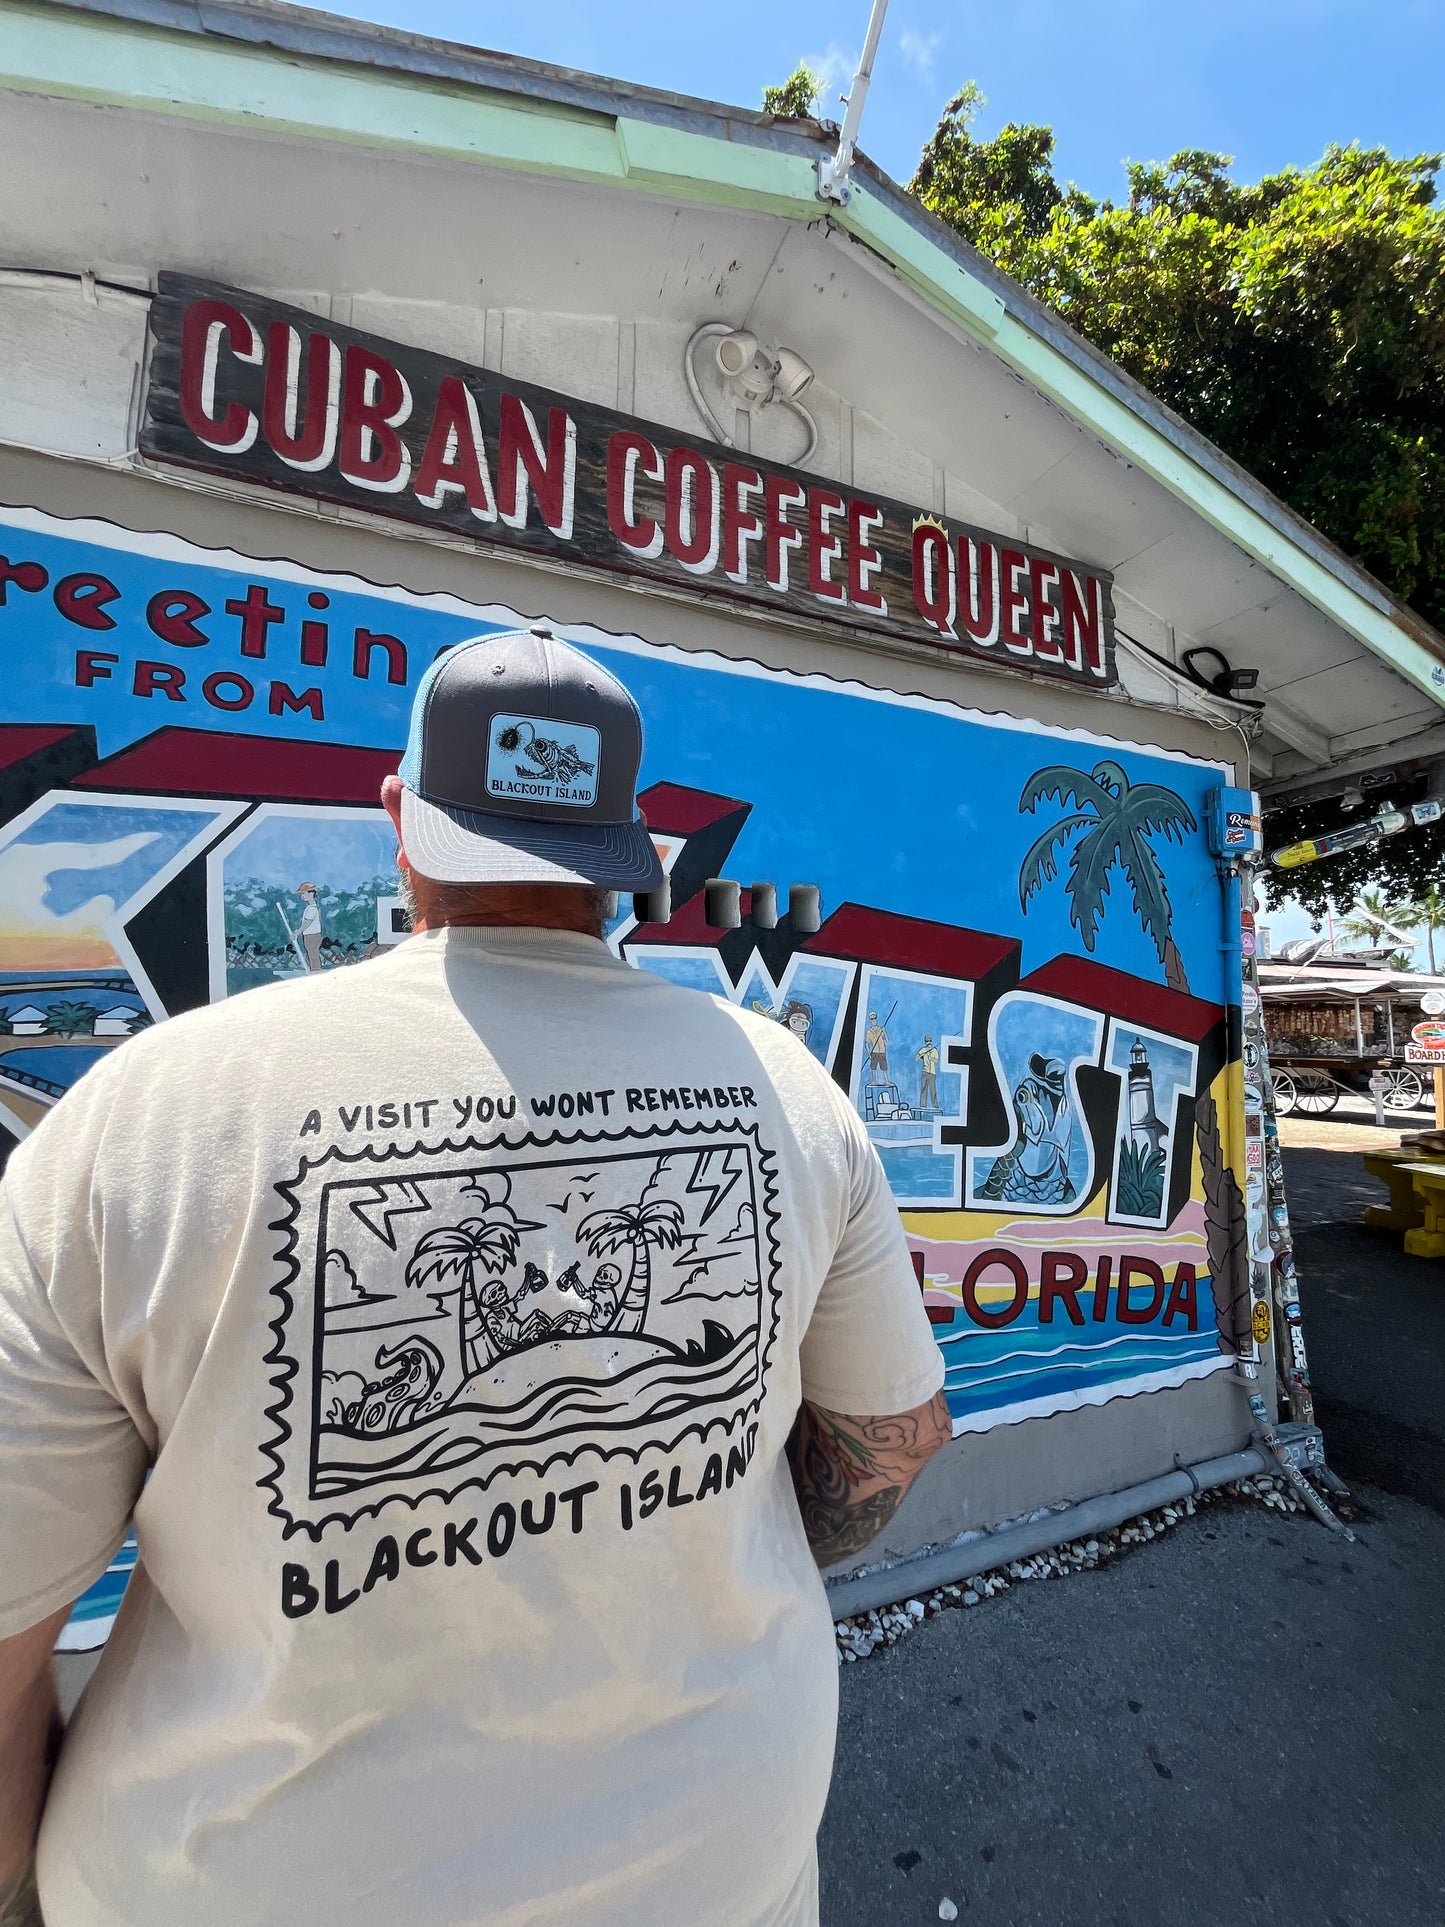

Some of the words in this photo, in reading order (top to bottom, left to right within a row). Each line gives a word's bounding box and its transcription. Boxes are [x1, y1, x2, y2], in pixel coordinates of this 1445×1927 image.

[180, 300, 578, 540] CUBAN
[607, 431, 889, 617] COFFEE
[912, 524, 1108, 678] QUEEN
[75, 650, 325, 720] FROM
[491, 779, 552, 797] BLACKOUT
[555, 787, 592, 801] ISLAND
[1409, 1048, 1441, 1061] BOARD
[299, 1109, 322, 1137] A
[338, 1098, 440, 1134] VISIT
[452, 1095, 518, 1130] YOU
[530, 1088, 617, 1120] WONT
[626, 1085, 758, 1113] REMEMBER
[281, 1480, 600, 1620] BLACKOUT
[620, 1421, 759, 1531] ISLAND
